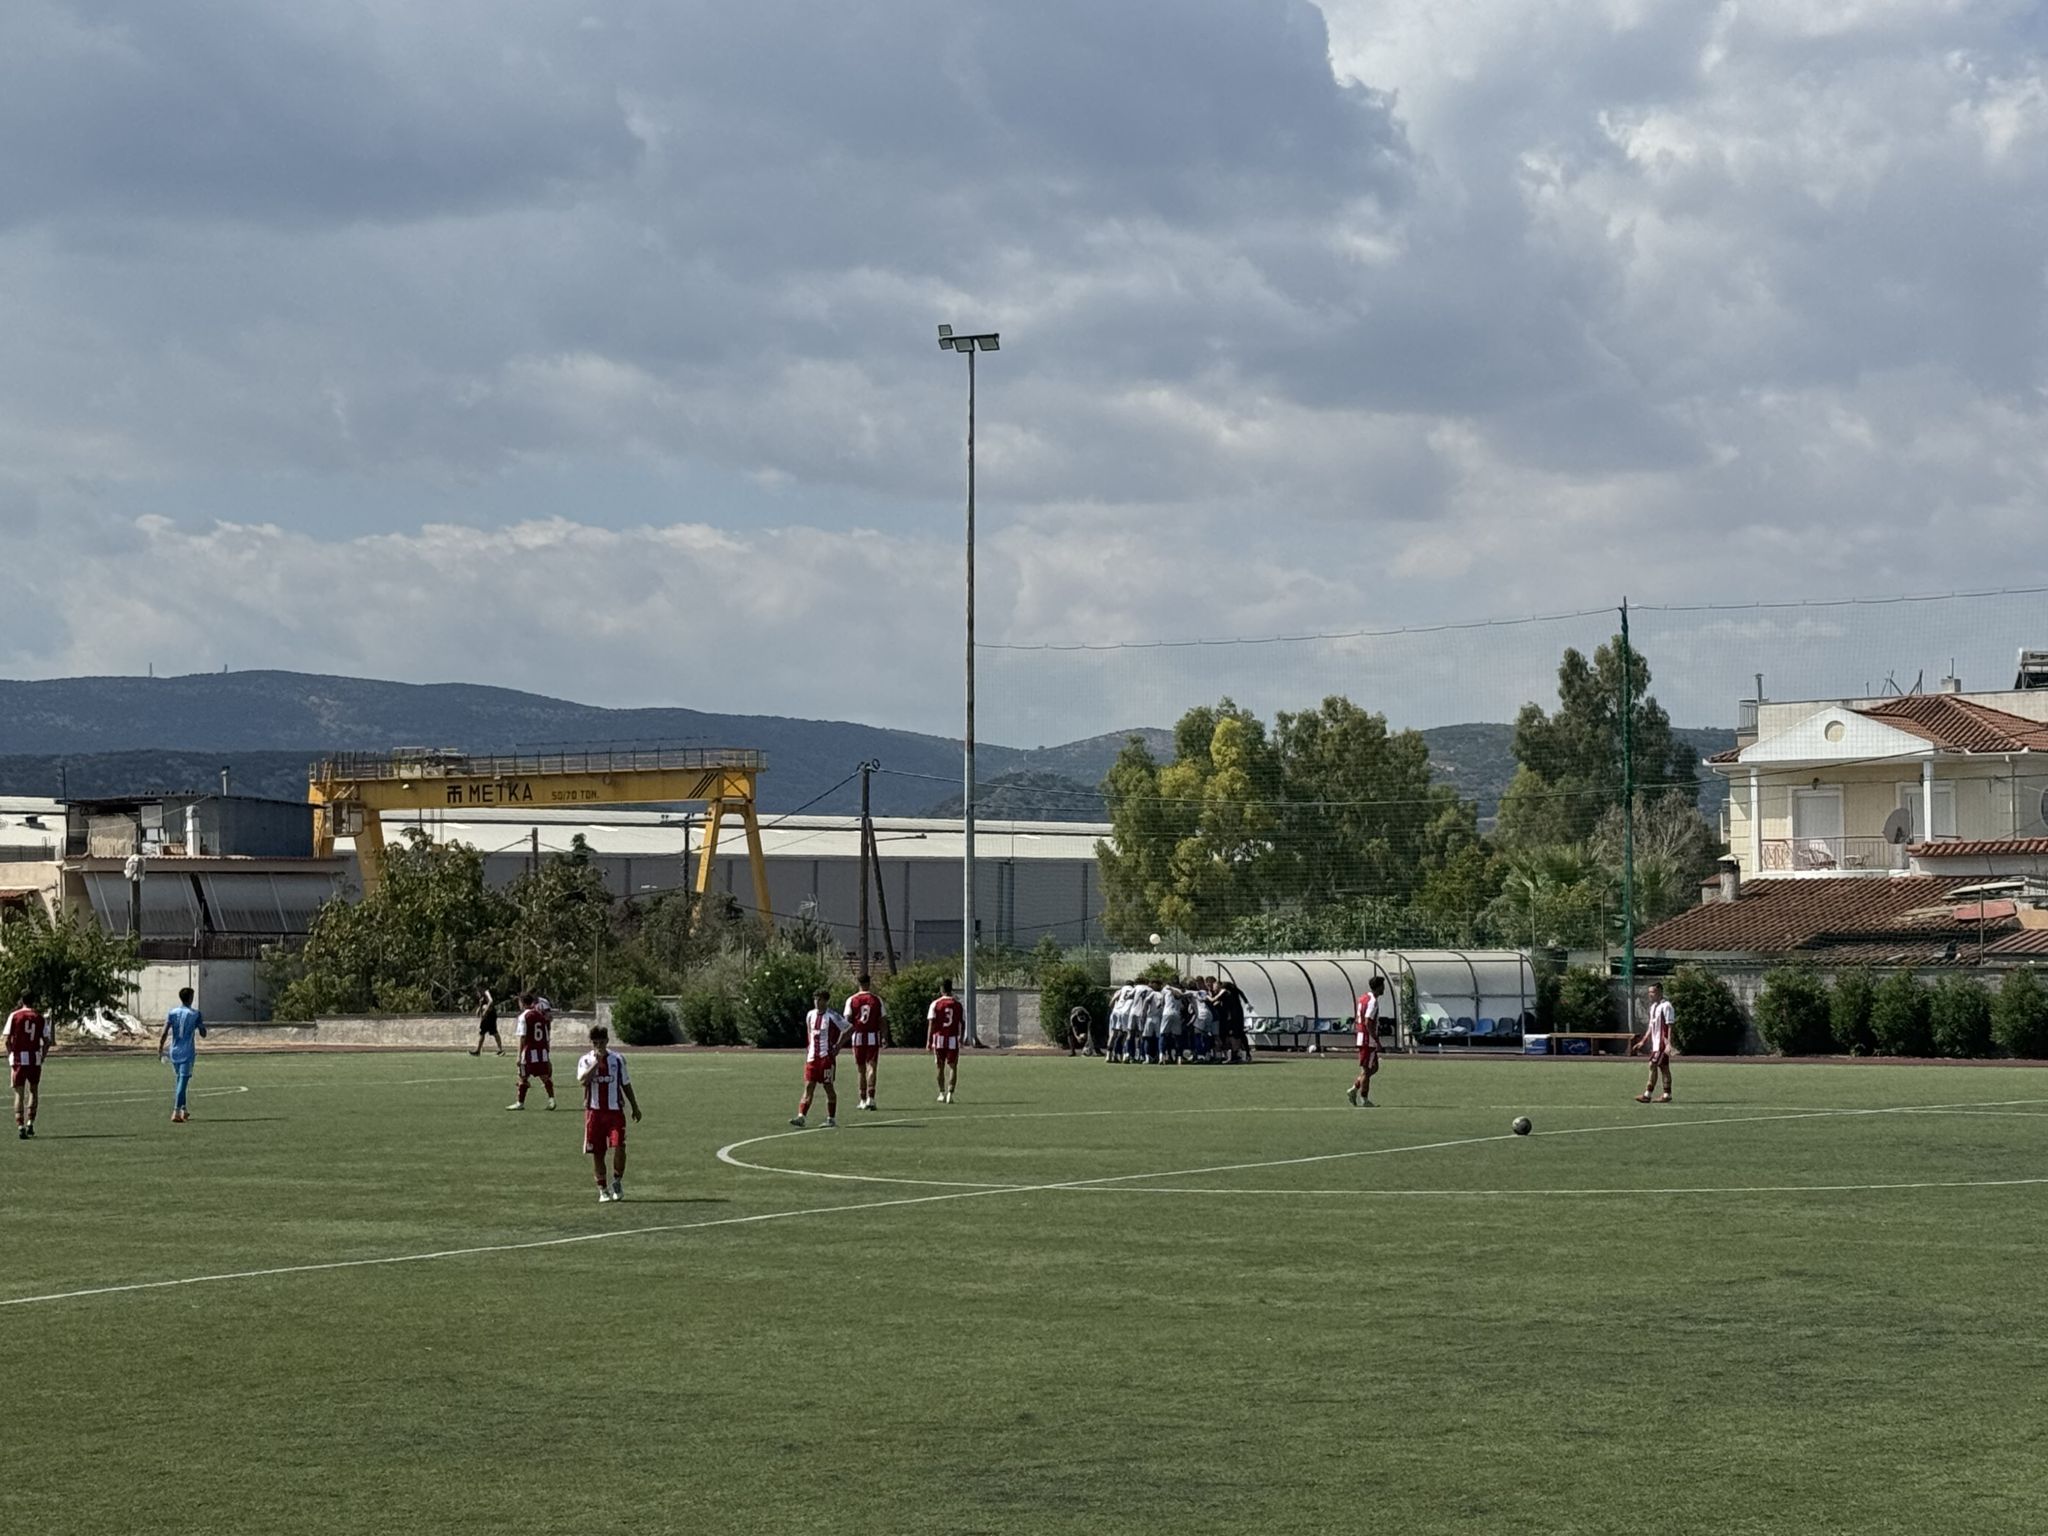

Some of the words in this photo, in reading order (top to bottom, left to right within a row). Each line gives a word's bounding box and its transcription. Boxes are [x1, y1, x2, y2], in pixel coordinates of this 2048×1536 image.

[468, 782, 534, 803] METKA
[942, 1007, 954, 1027] 3
[24, 1020, 36, 1042] 4
[534, 1022, 543, 1041] 6
